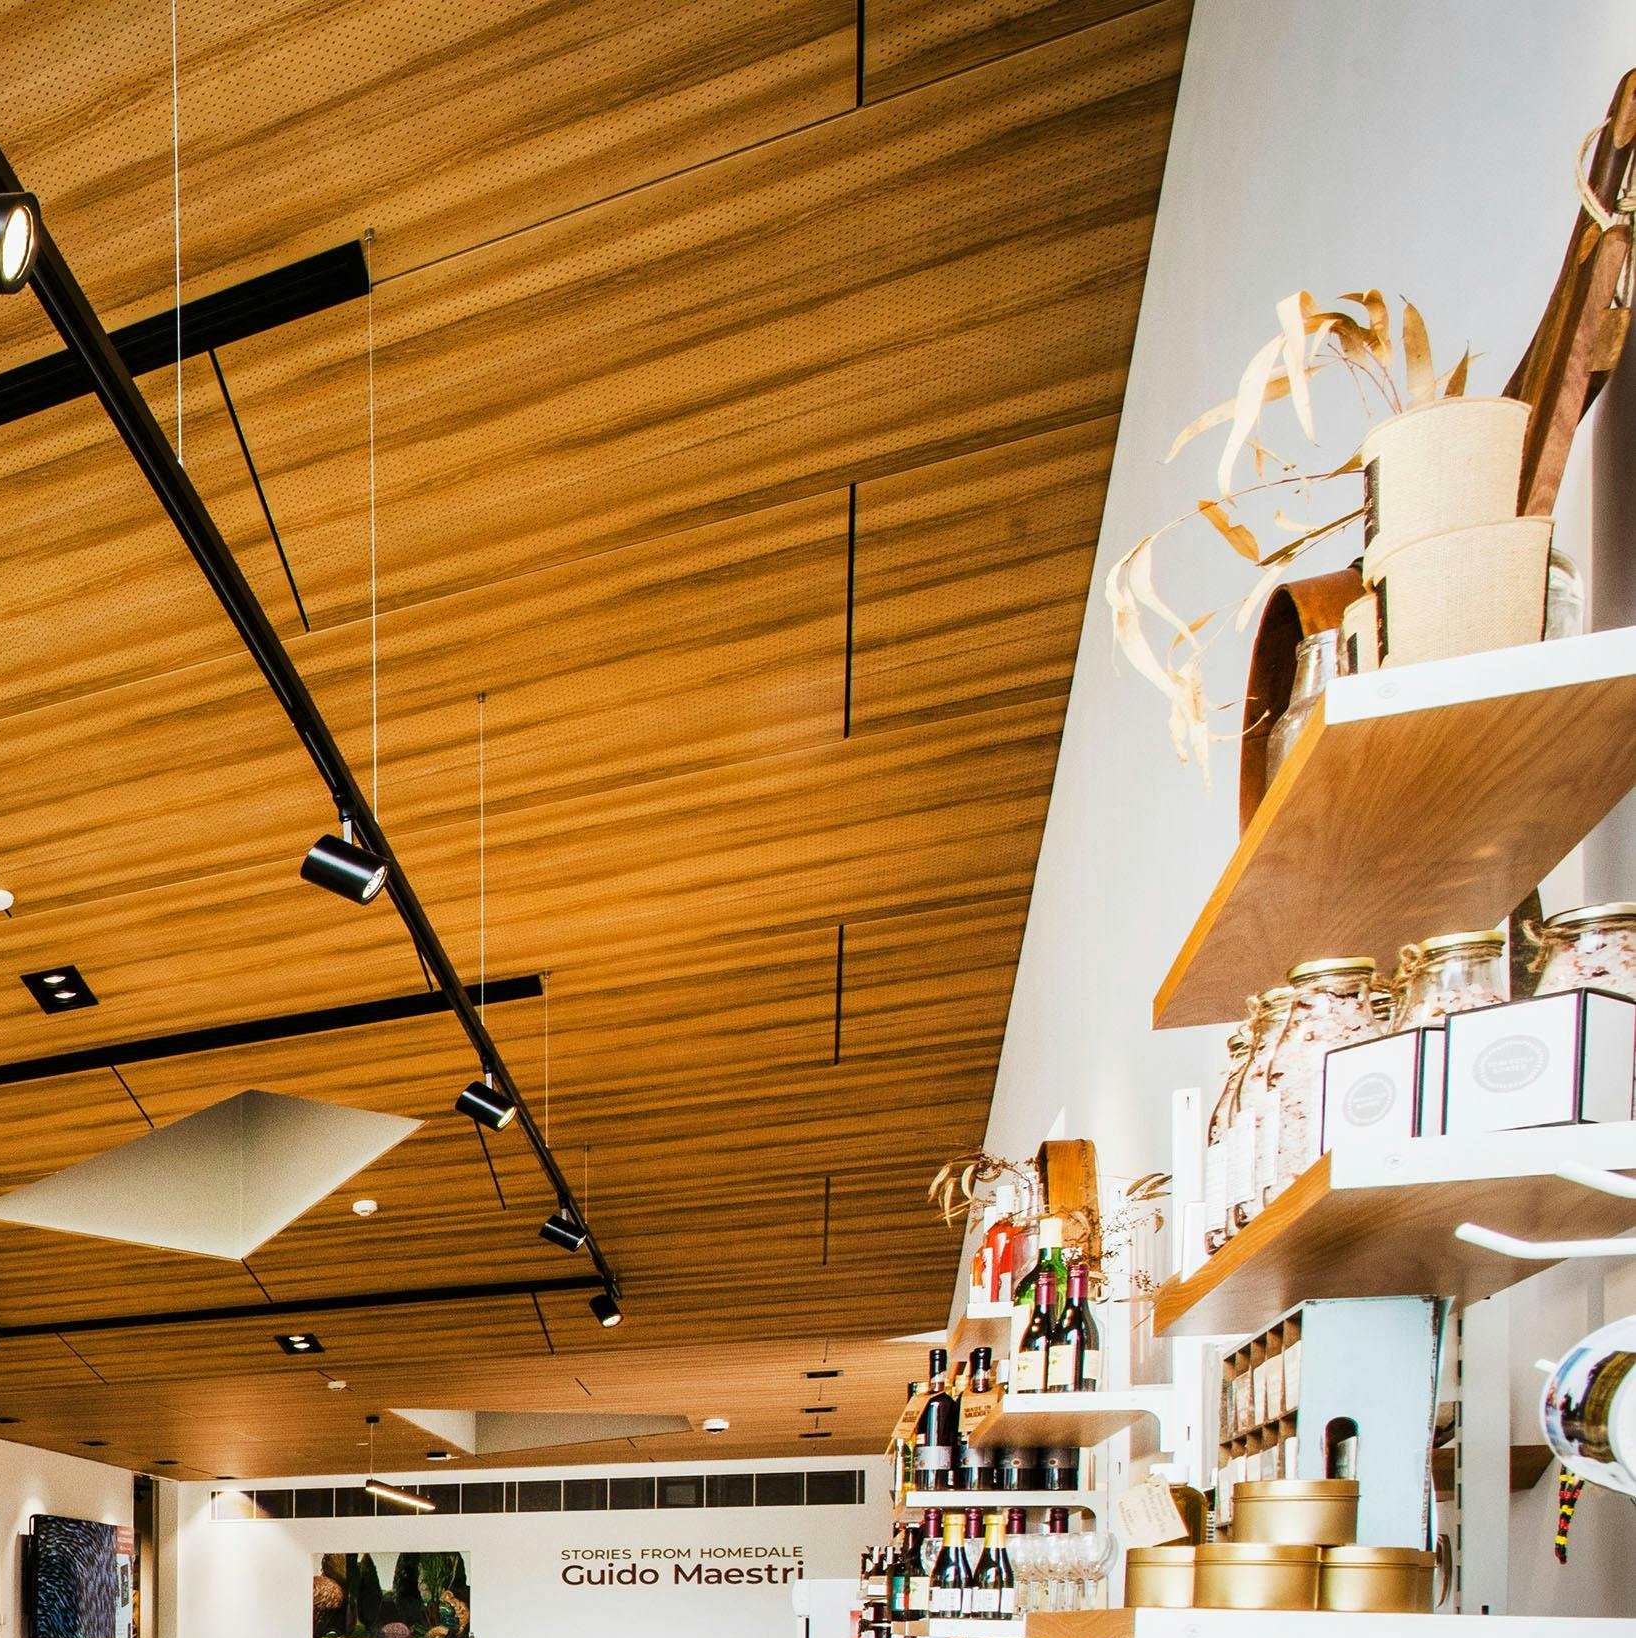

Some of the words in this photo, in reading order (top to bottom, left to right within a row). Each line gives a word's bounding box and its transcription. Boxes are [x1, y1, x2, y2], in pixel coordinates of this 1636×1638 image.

[561, 1548, 632, 1561] STORIES
[640, 1548, 693, 1560] FROM
[700, 1546, 804, 1558] HOMEDALE
[561, 1563, 659, 1586] Guido
[673, 1561, 805, 1585] Maestri
